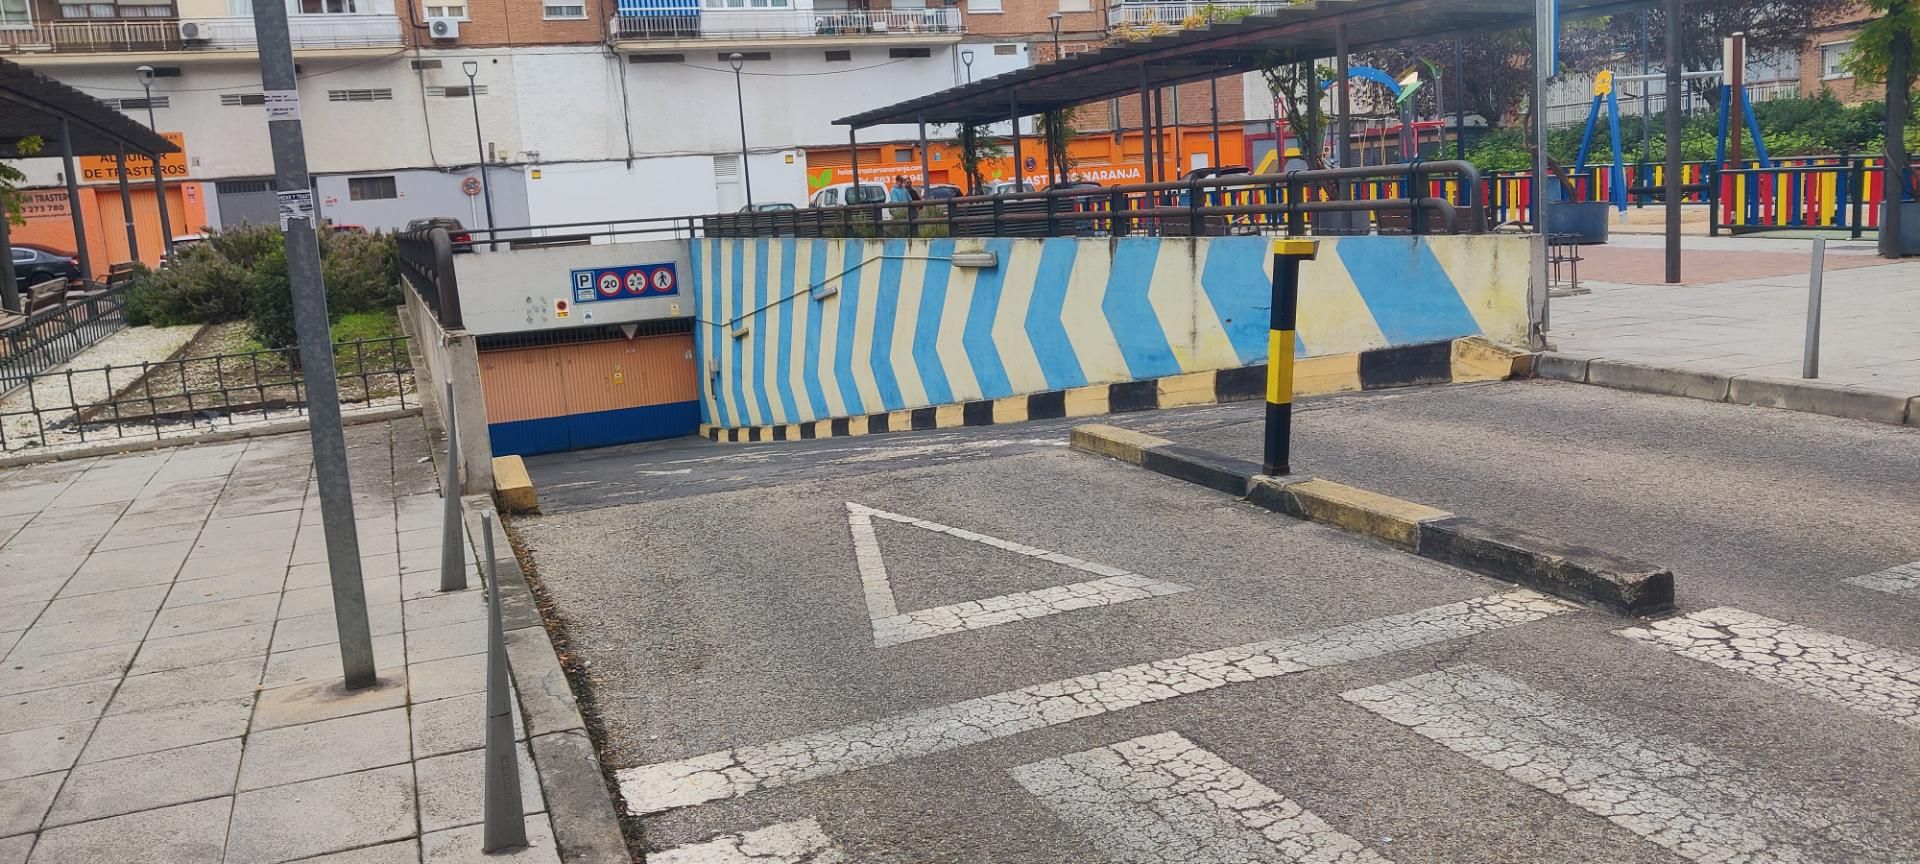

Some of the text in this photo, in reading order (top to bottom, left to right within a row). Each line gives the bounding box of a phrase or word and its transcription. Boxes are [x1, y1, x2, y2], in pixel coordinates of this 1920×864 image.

[84, 168, 102, 179] DE
[1082, 167, 1141, 182] NARANJA
[580, 275, 589, 287] P
[603, 279, 617, 289] 20
[630, 279, 635, 287] 2
